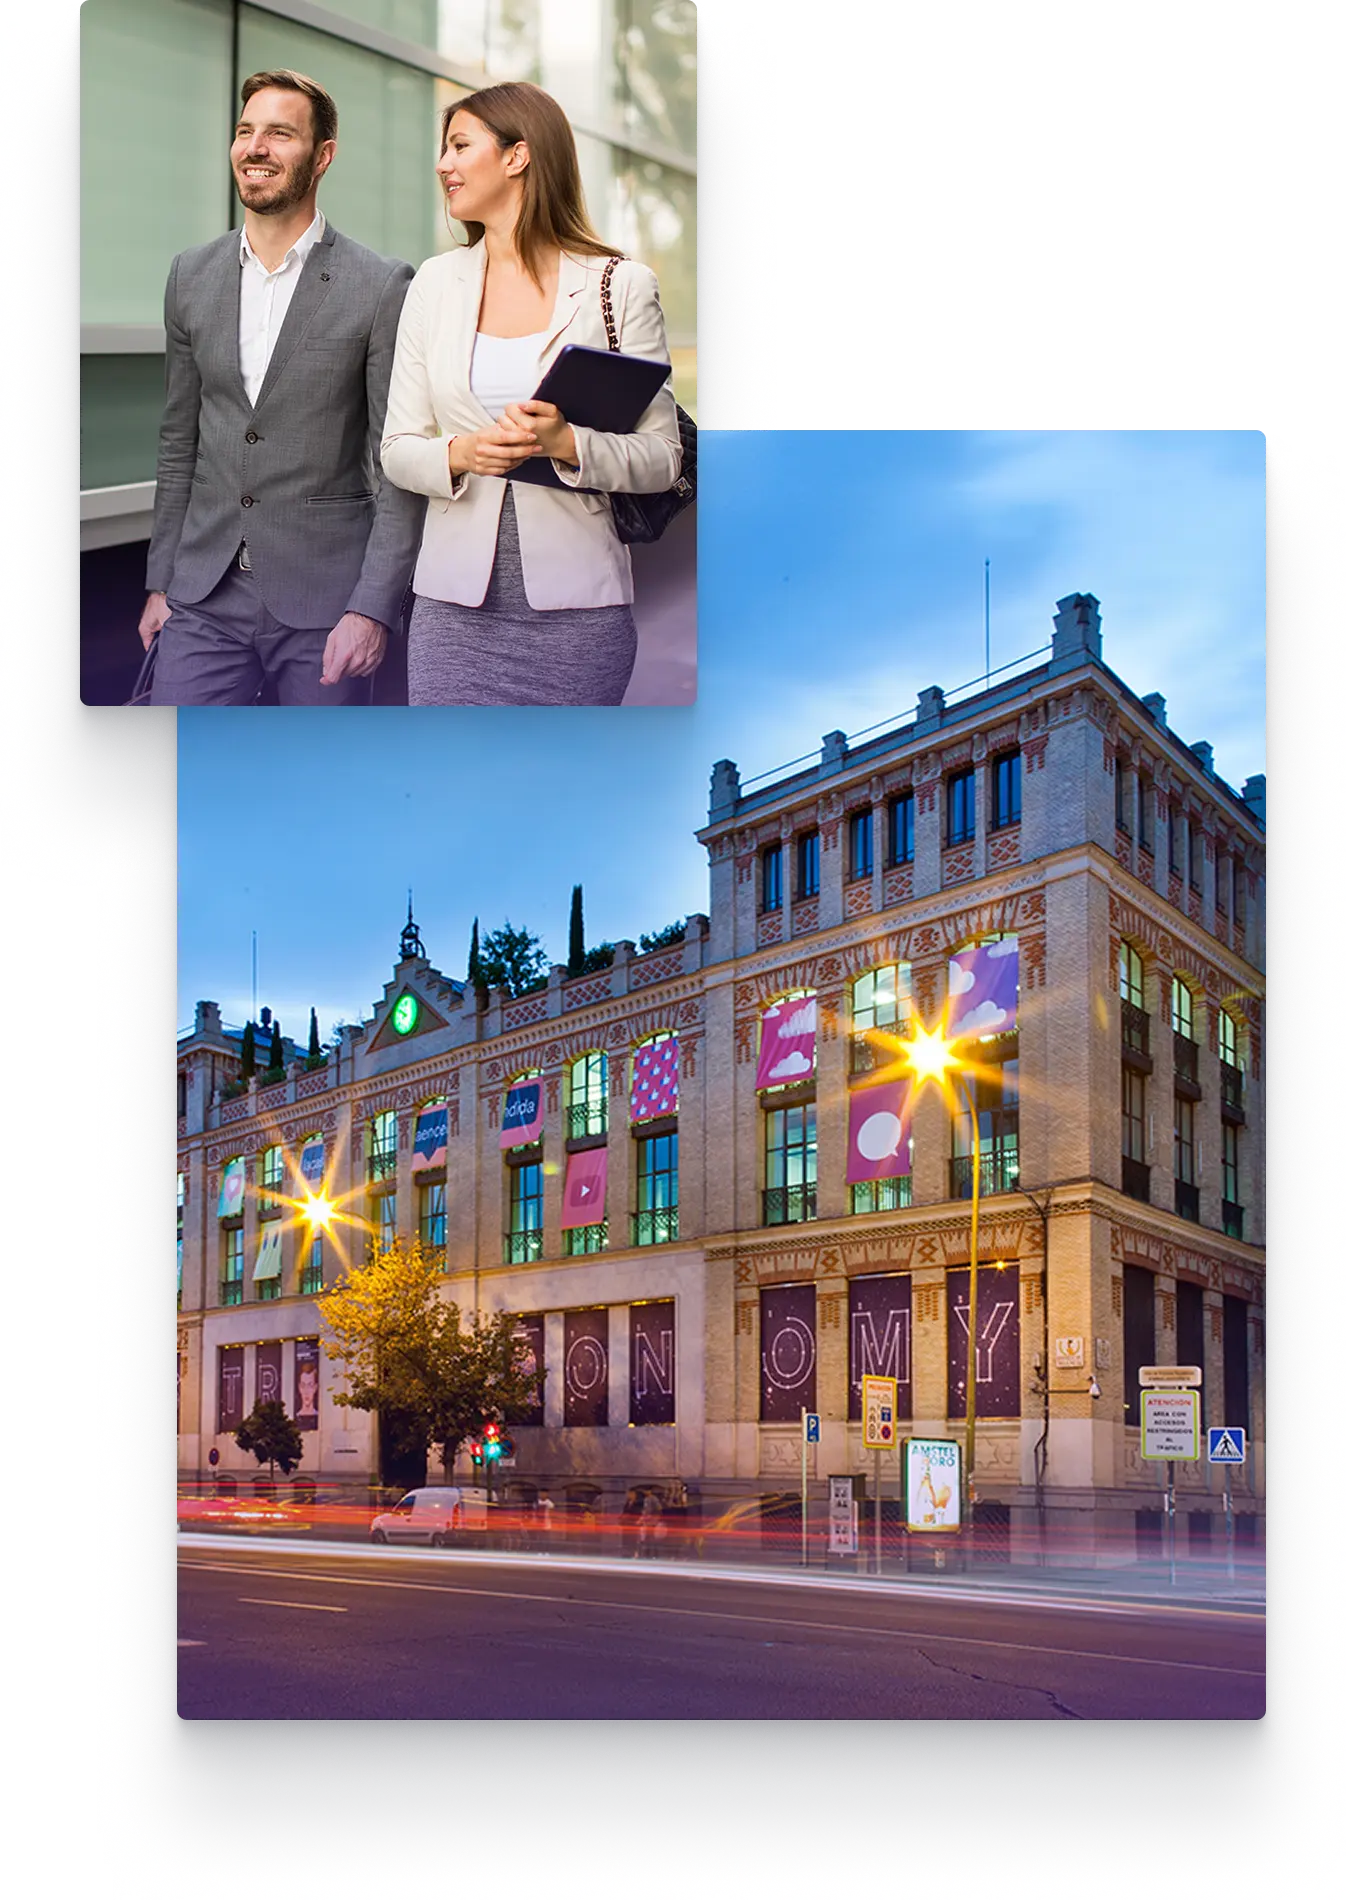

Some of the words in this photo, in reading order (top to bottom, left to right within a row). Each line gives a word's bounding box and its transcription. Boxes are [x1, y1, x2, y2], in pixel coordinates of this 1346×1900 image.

[635, 1329, 673, 1396] N
[851, 1308, 910, 1385] M
[953, 1301, 1015, 1383] Y
[221, 1365, 242, 1414] T
[258, 1363, 279, 1405] R
[808, 1417, 817, 1431] P
[912, 1444, 954, 1457] AMSTEL
